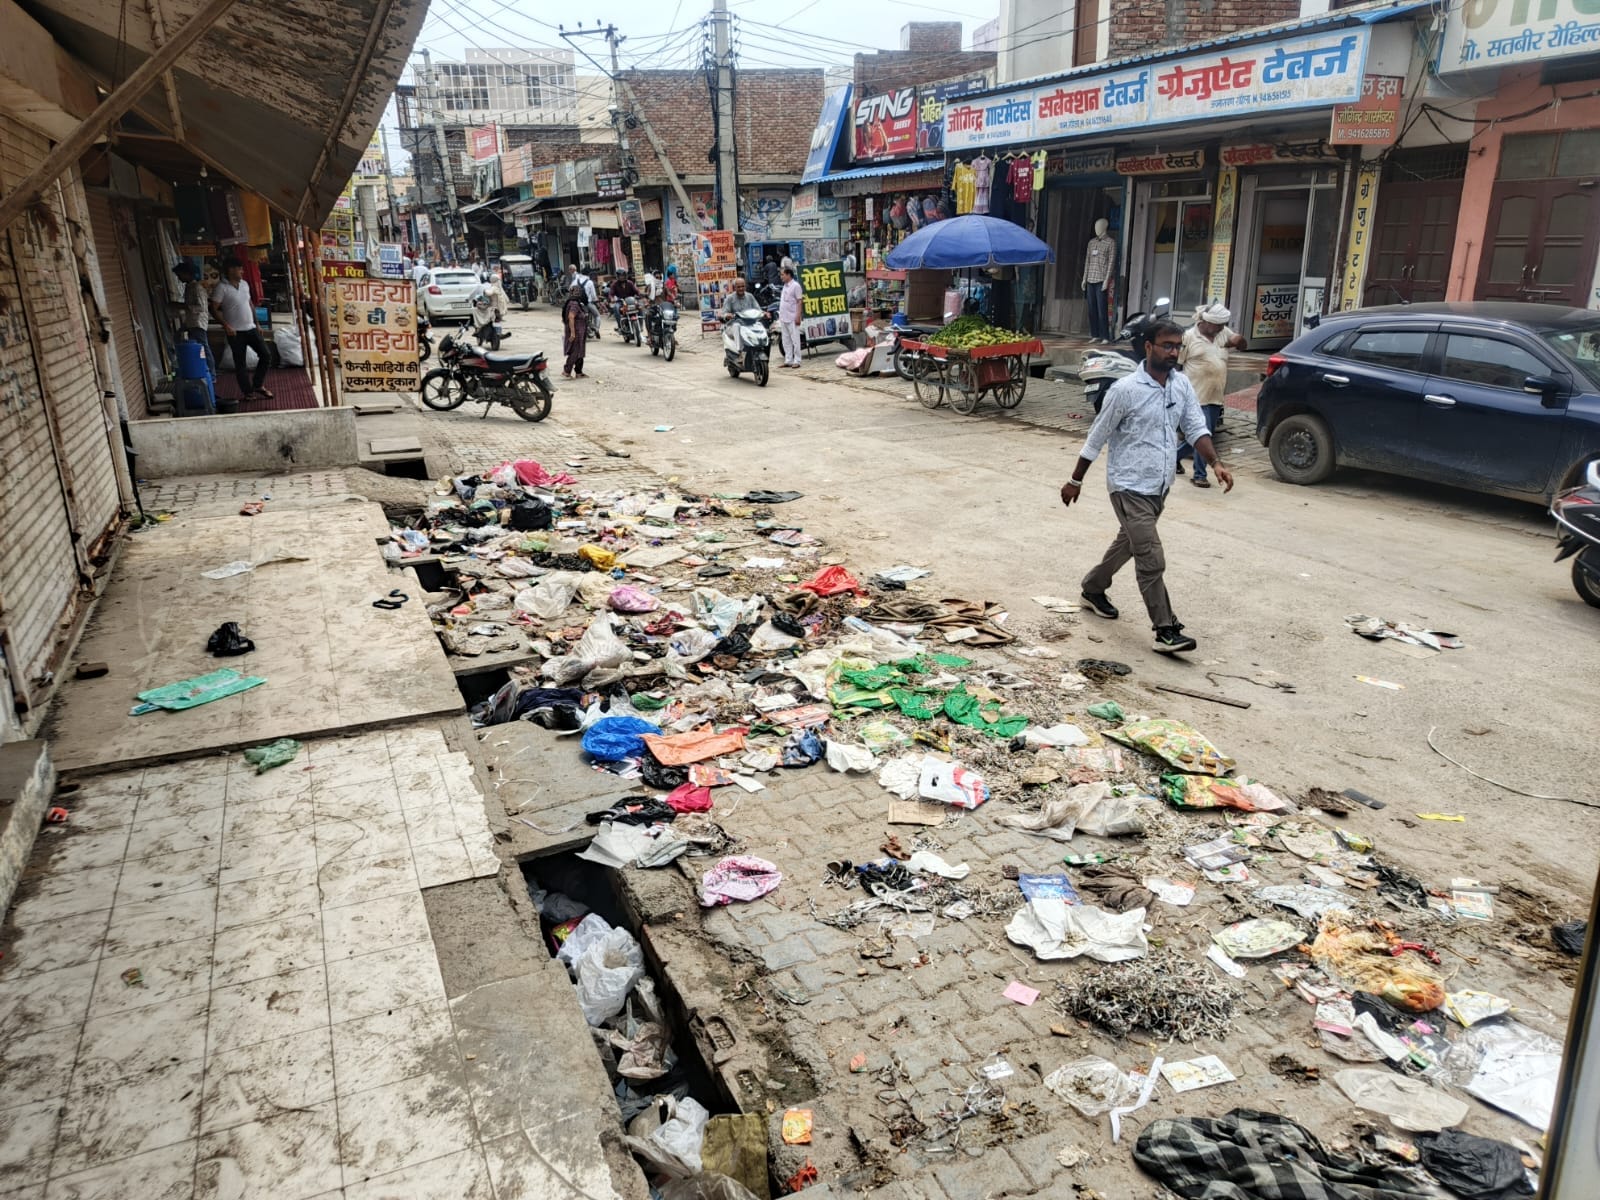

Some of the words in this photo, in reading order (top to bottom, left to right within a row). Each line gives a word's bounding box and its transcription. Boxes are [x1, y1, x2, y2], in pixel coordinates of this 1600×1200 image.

[1459, 39, 1481, 64] प्रो.
[1487, 28, 1545, 58] सतबीर
[1262, 35, 1358, 84] टेलर्ज
[1103, 70, 1149, 108] टेलर्ज
[857, 88, 915, 125] STING
[801, 267, 841, 291] रोहित
[367, 307, 387, 324] ही
[820, 294, 846, 314] हाउस
[405, 361, 418, 374] की
[386, 377, 416, 391] दुकान
